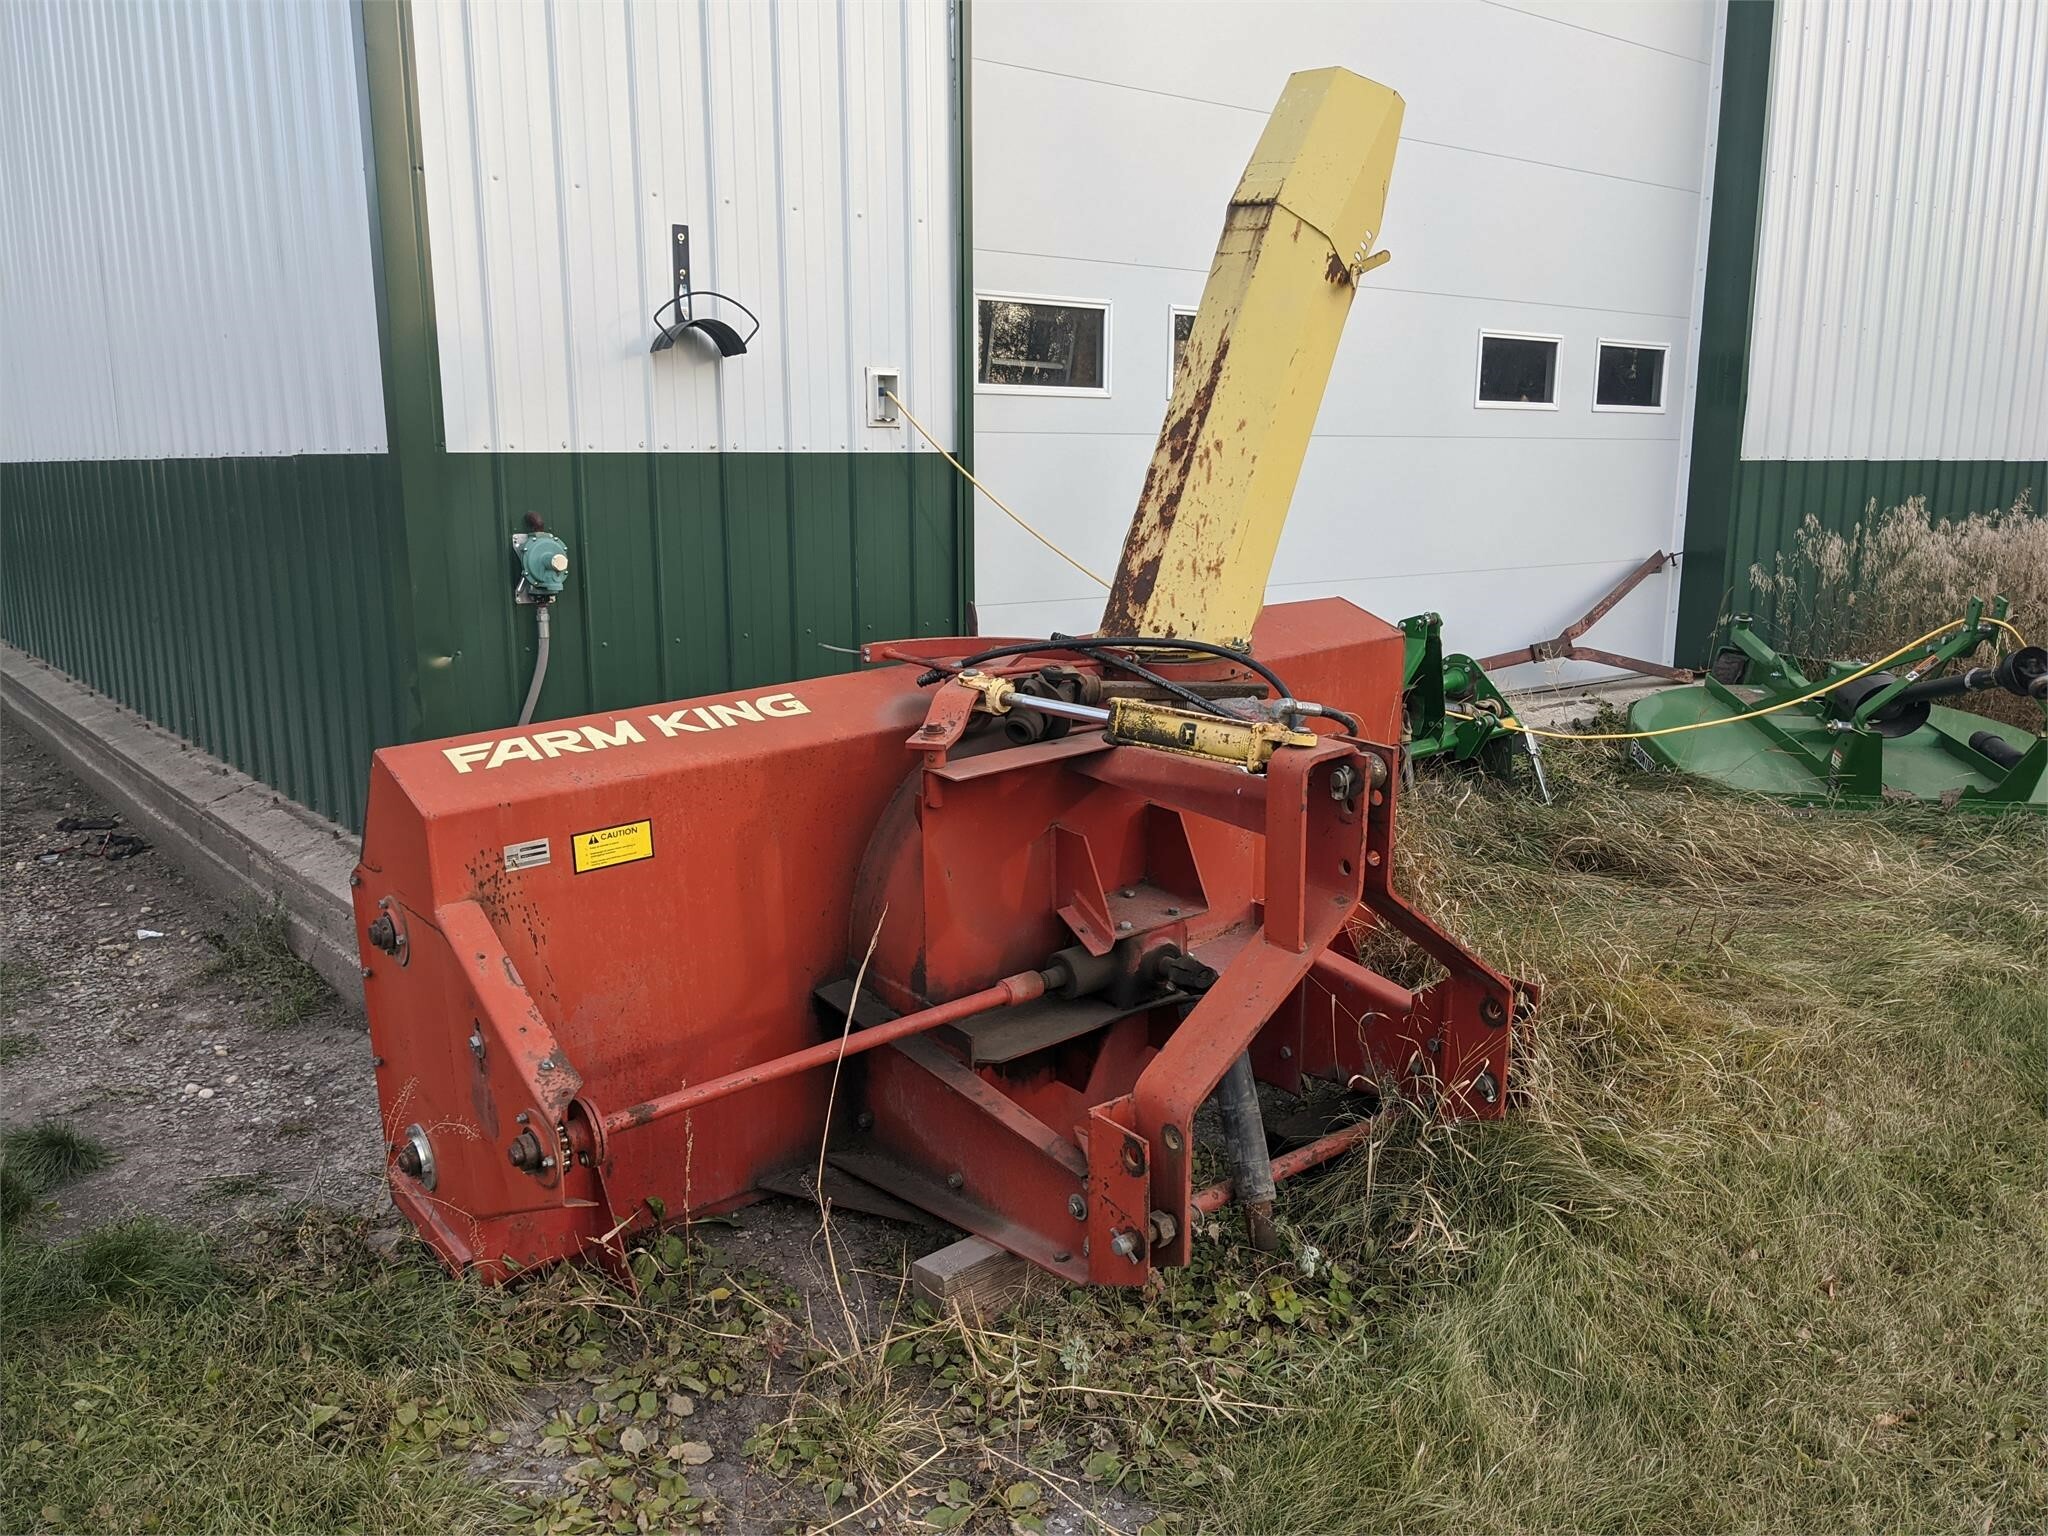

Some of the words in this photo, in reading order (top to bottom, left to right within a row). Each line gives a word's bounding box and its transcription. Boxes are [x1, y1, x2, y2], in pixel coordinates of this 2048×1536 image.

[442, 720, 646, 773] FARM
[649, 693, 811, 737] KING
[600, 827, 638, 841] CAUTION
